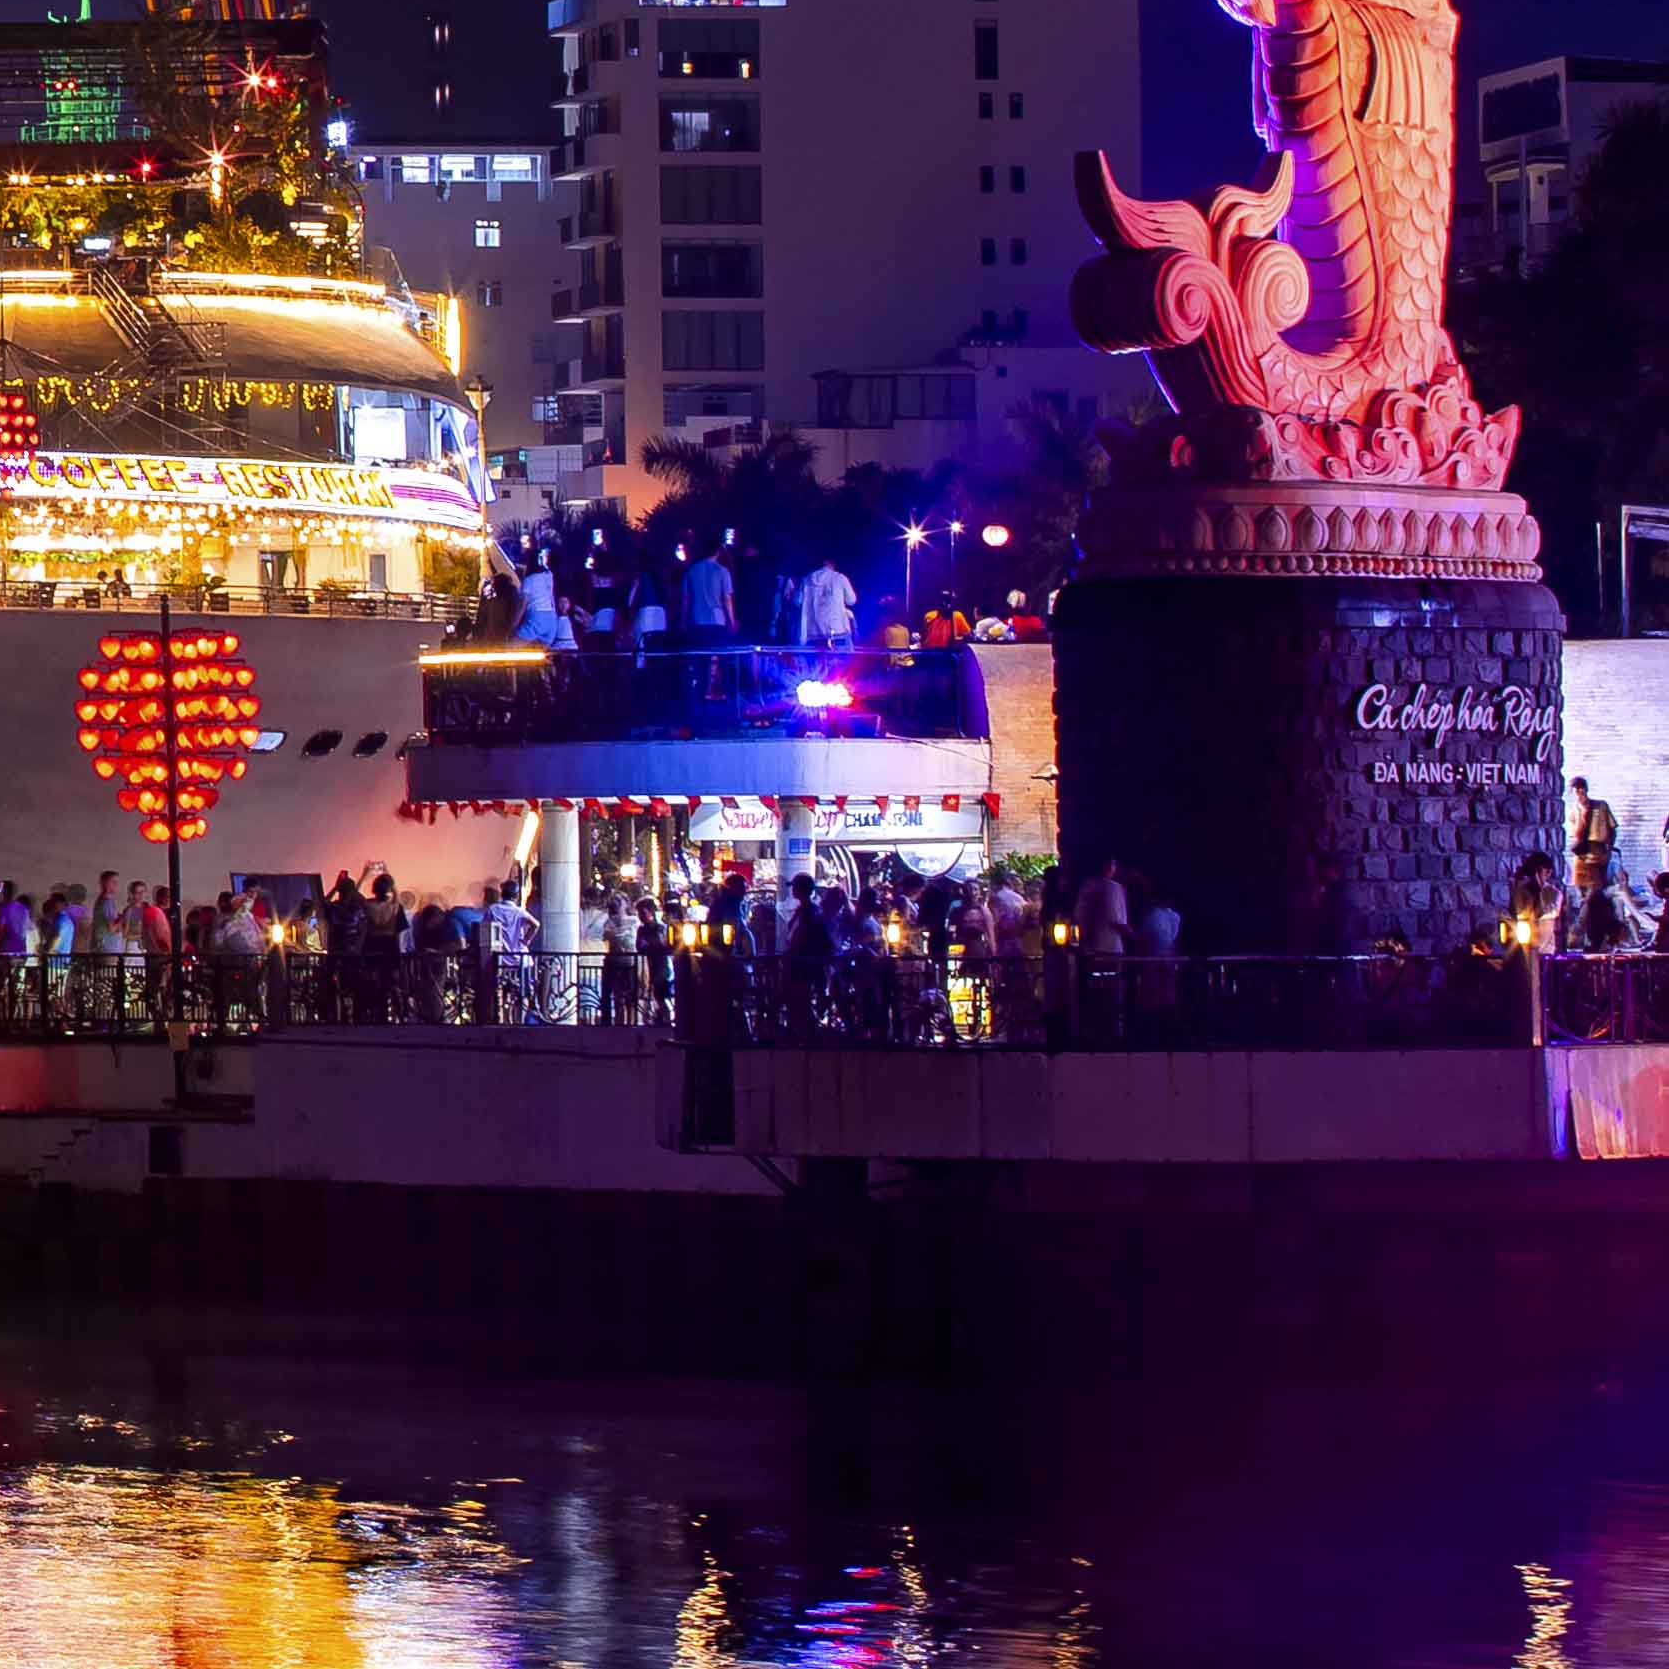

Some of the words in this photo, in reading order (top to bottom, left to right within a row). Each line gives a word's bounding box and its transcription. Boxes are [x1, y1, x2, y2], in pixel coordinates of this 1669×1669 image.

[28, 456, 199, 493] COFFEE
[1357, 683, 1399, 730] Cá
[1401, 683, 1455, 749] chép
[1457, 685, 1499, 731] hóa
[1502, 685, 1556, 762] Rồng
[1374, 755, 1399, 783] ĐÀ
[1505, 763, 1541, 784] NAM
